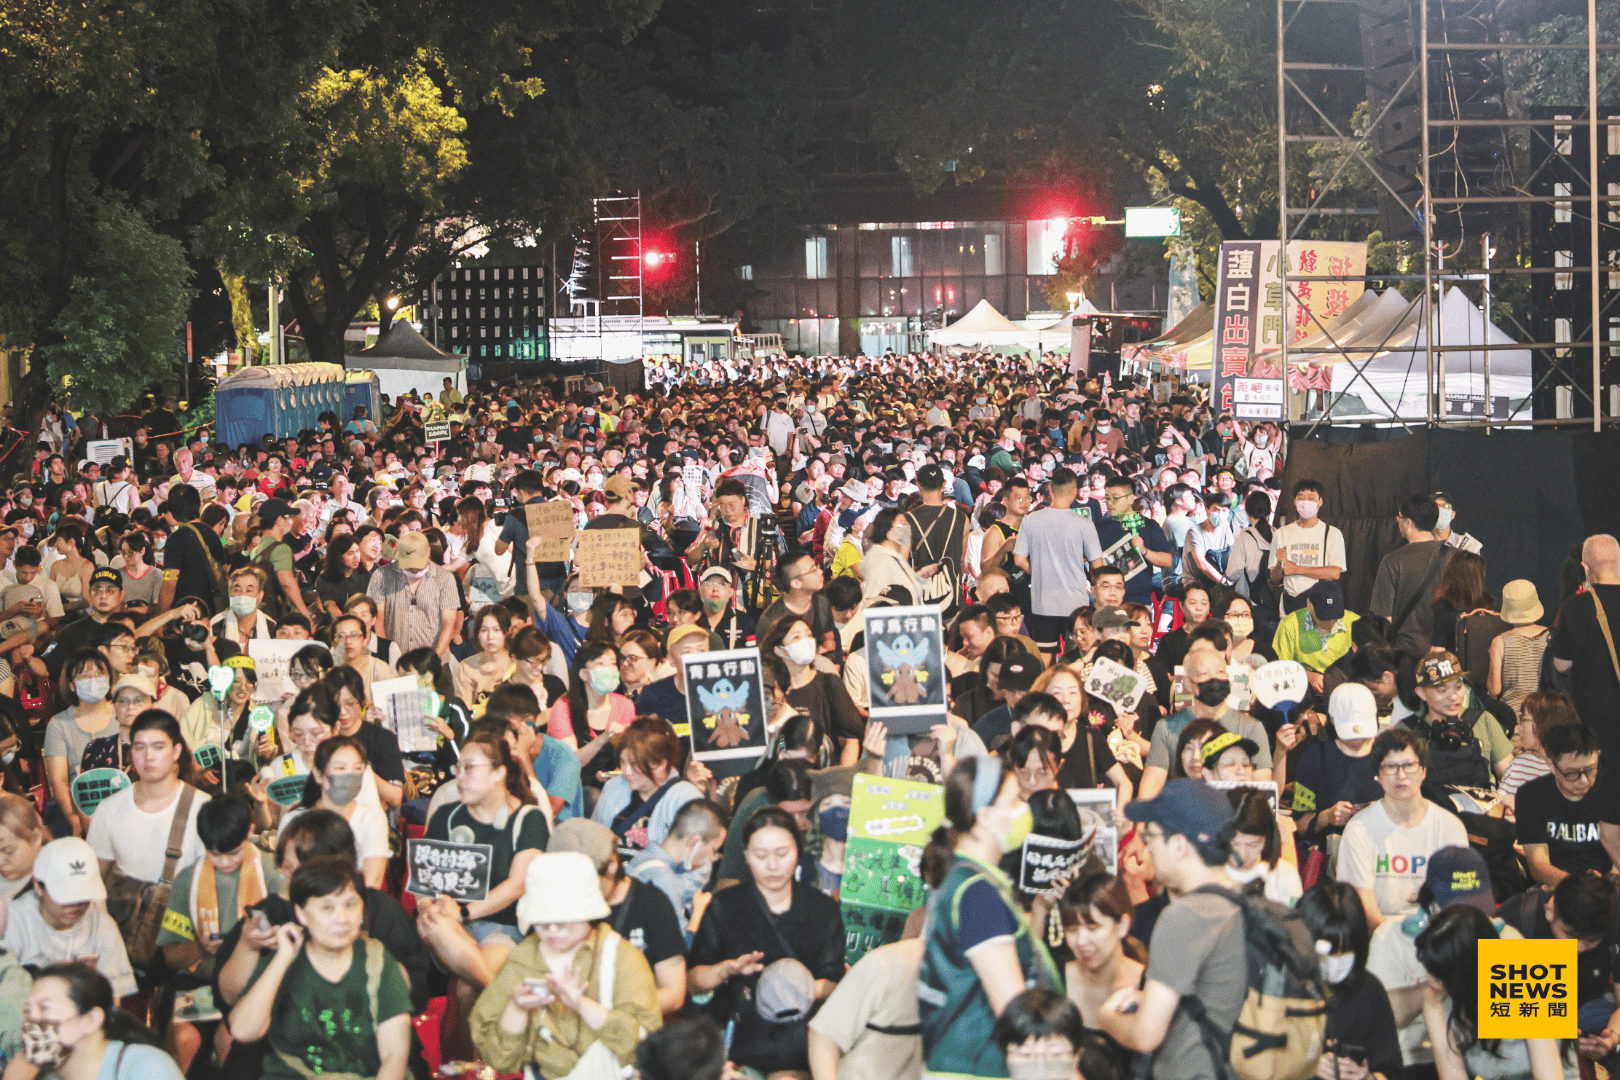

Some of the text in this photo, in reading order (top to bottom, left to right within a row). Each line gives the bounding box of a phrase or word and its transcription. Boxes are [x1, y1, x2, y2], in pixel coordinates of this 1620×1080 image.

[870, 616, 936, 634] 青鳥行動
[690, 660, 755, 679] 青鳥行動
